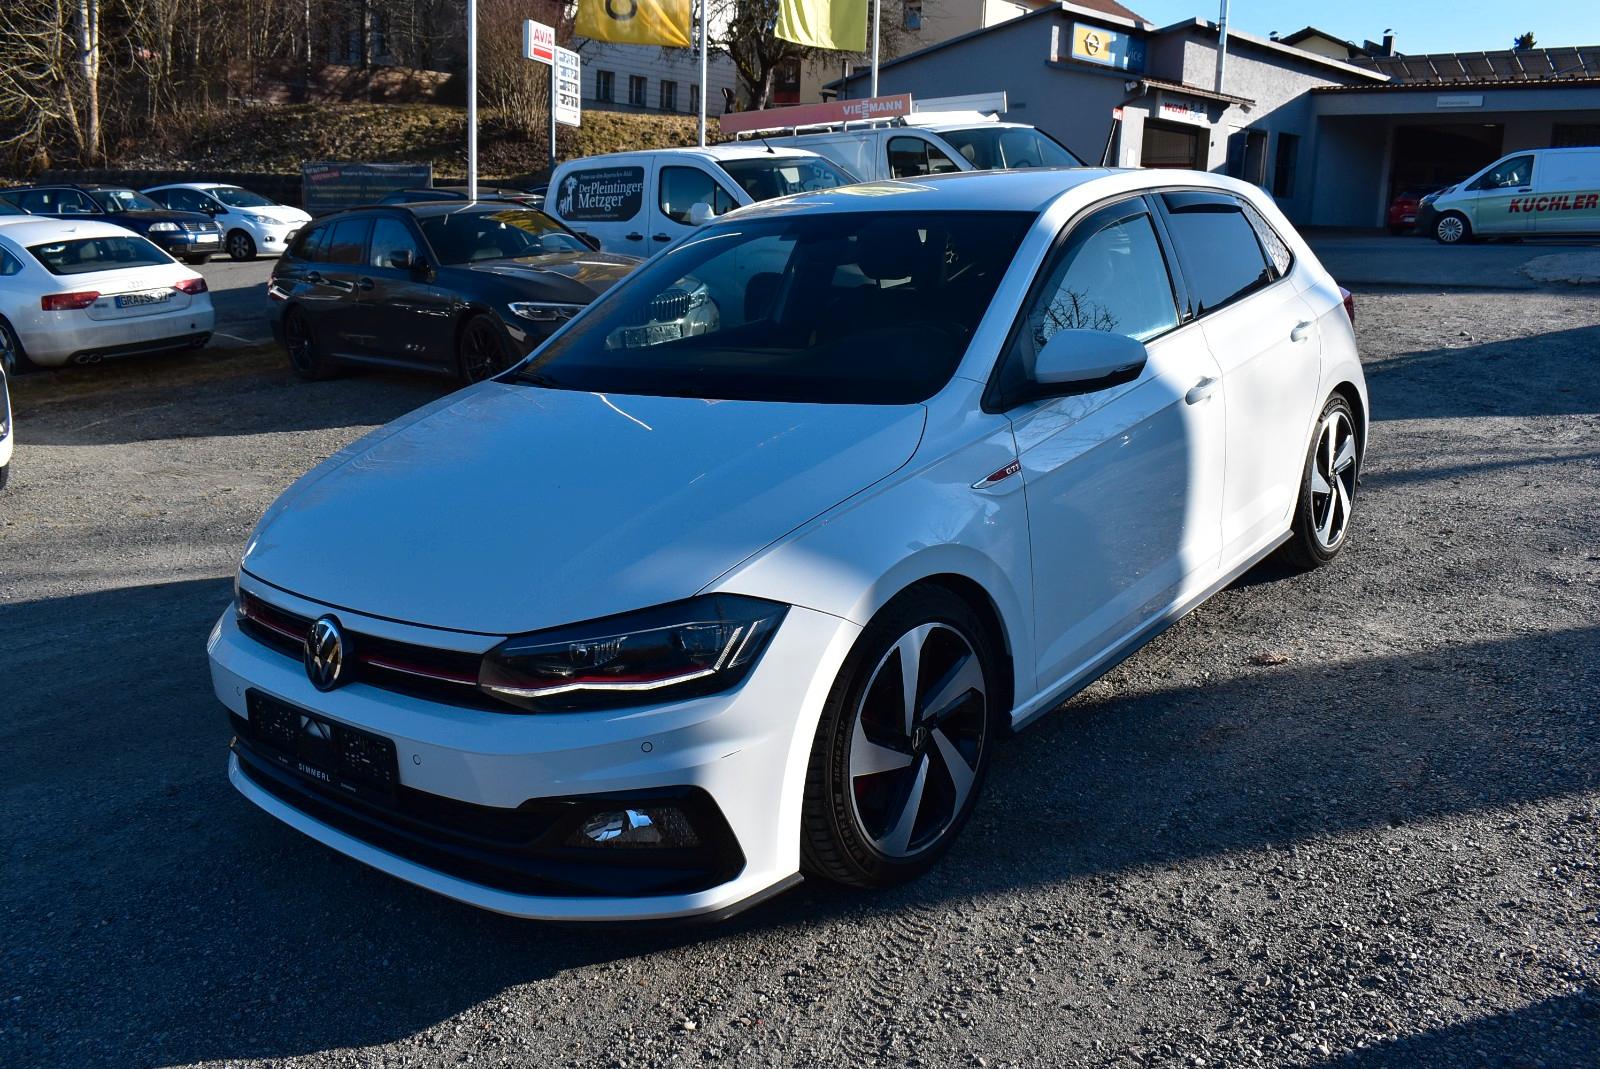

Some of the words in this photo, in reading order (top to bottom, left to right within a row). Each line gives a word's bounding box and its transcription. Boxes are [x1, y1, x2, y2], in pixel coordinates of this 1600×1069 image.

[534, 29, 553, 46] AVIA
[843, 100, 903, 119] VIESSMANN
[1164, 102, 1188, 114] wash
[579, 184, 592, 193] Der
[577, 193, 624, 212] Metzger
[121, 295, 139, 305] GRA
[1006, 463, 1019, 475] GTI
[298, 762, 330, 783] SIMMERL
